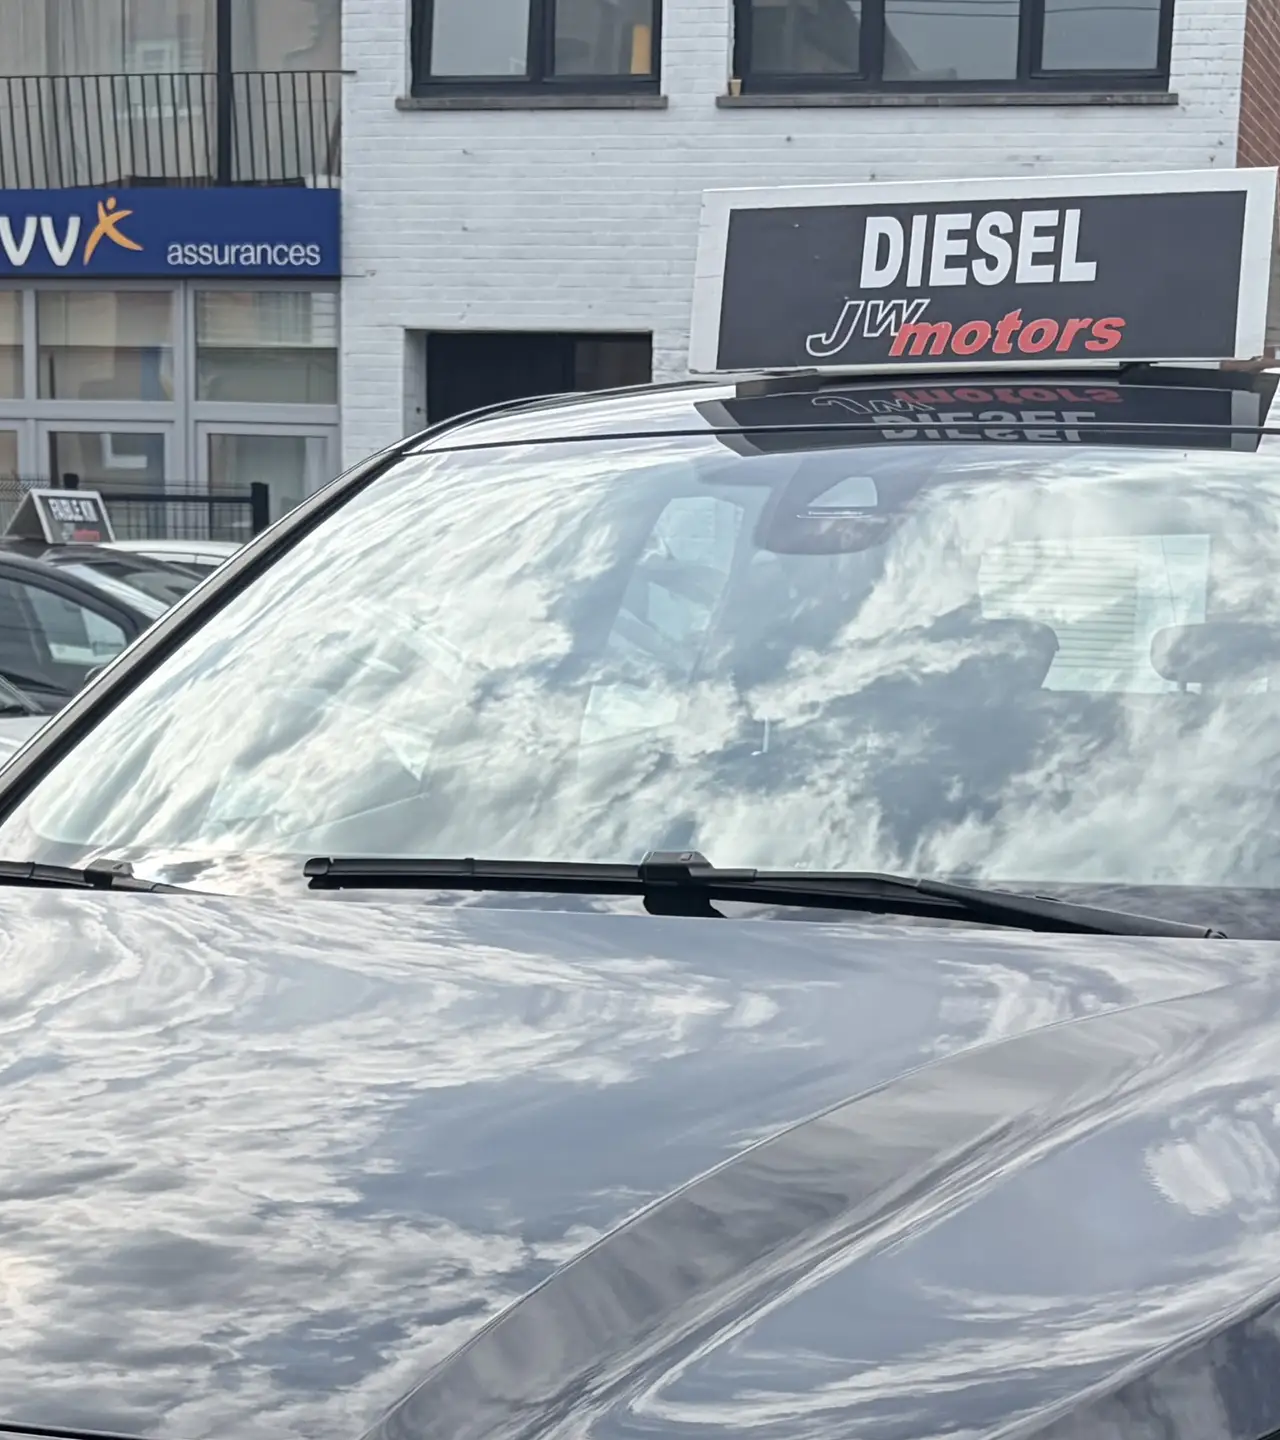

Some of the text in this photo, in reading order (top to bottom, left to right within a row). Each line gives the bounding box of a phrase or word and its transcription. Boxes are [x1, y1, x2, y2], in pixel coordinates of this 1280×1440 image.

[166, 241, 321, 267] assurances
[859, 208, 1097, 289] DIESEL
[805, 298, 1126, 357] JW motors
